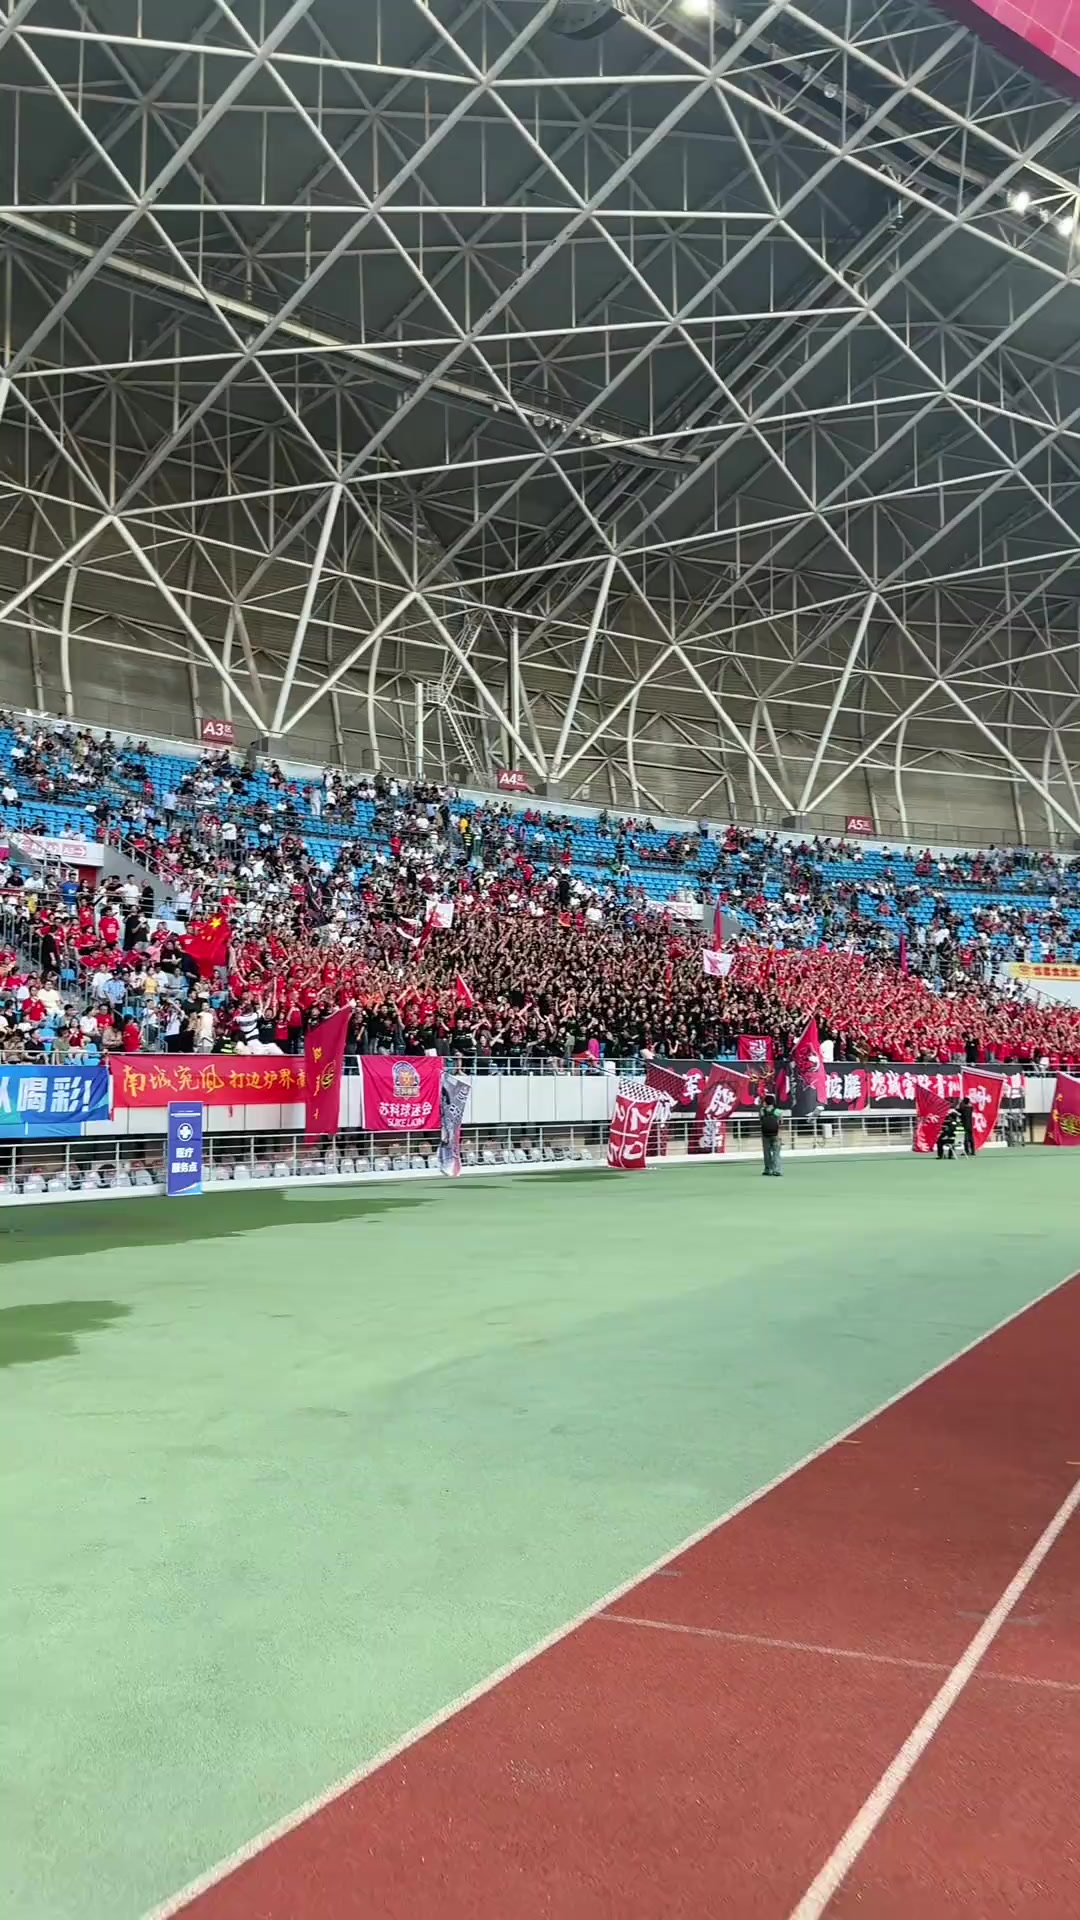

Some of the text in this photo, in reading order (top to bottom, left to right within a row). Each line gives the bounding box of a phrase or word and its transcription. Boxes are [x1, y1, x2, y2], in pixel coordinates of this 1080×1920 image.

[175, 1147, 194, 1159] 医疗
[171, 1162, 198, 1173] 服务点
